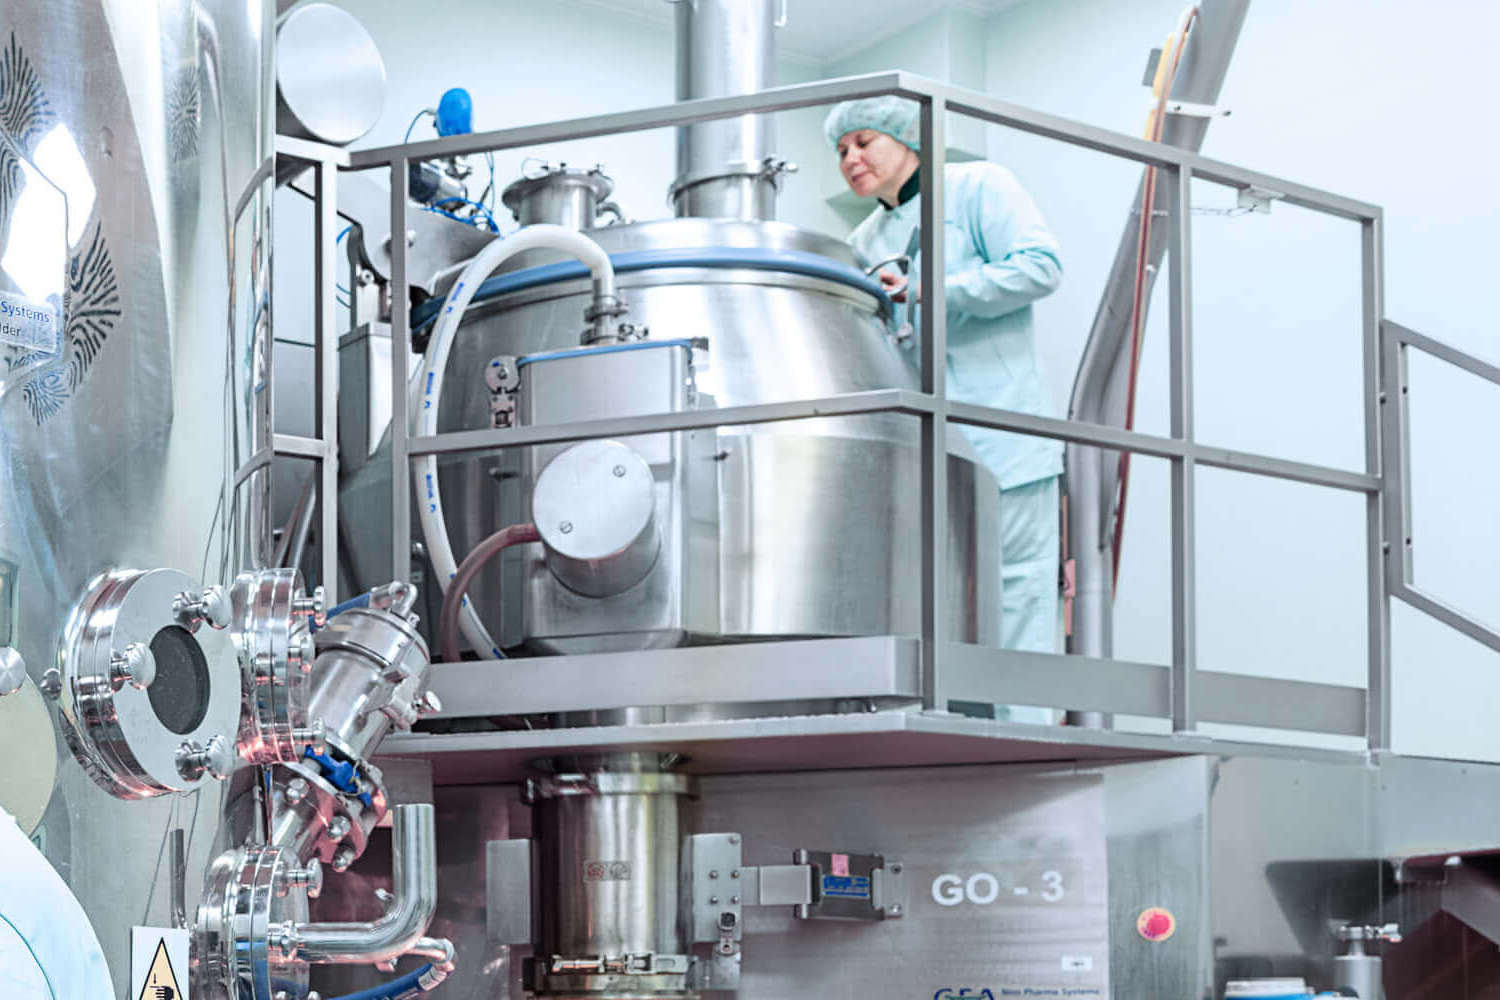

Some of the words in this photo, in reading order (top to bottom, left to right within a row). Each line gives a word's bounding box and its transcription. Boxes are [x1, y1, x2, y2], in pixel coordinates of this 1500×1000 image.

[1, 300, 50, 323] Systems
[931, 872, 1000, 907] GO
[1013, 886, 1029, 896] -
[1041, 870, 1065, 902] 3
